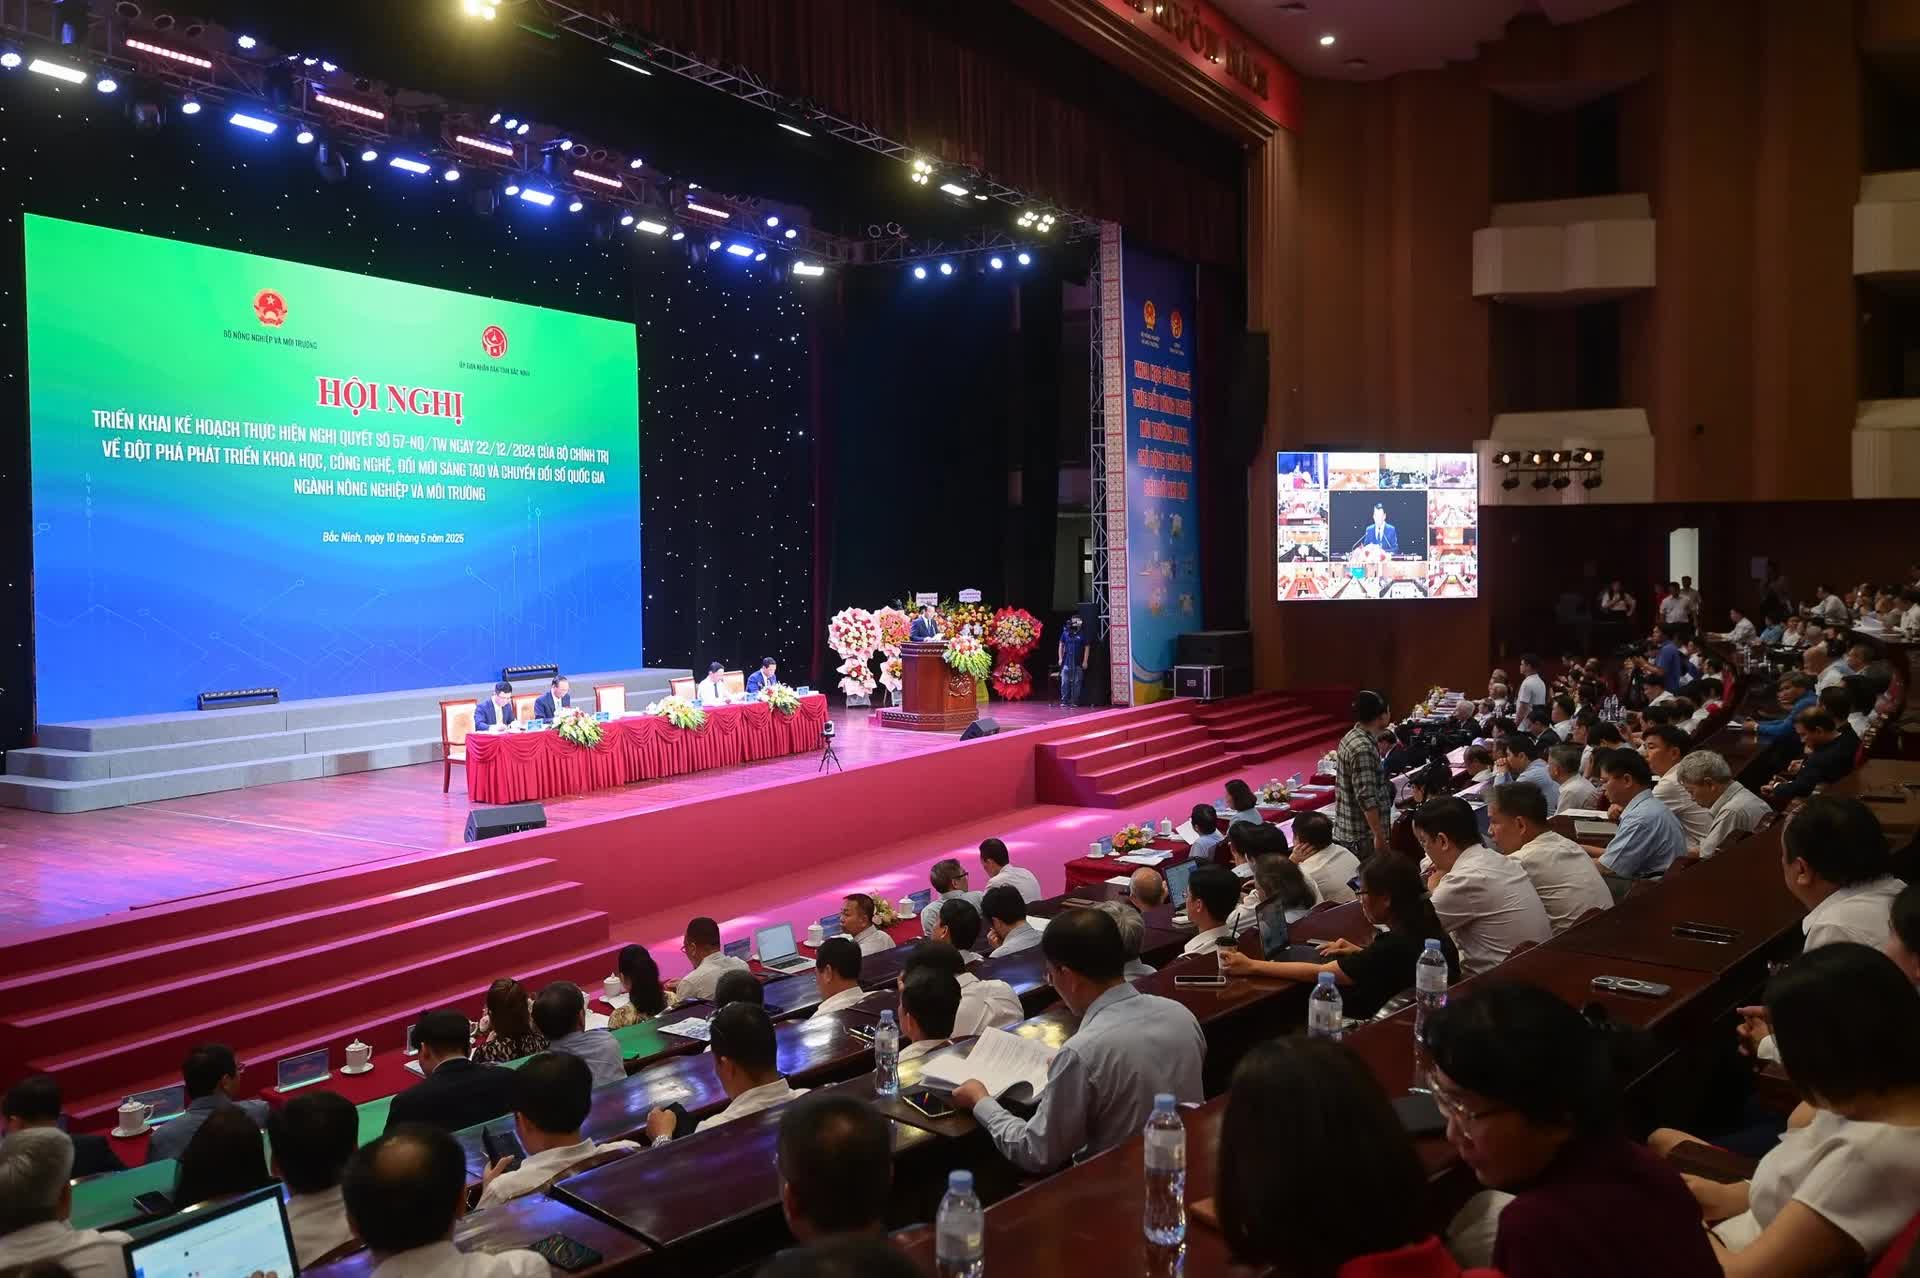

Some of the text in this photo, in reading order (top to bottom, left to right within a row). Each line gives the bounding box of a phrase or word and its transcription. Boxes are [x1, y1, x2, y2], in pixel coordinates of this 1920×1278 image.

[316, 375, 464, 426] HỘI NGHỊ
[92, 407, 134, 430] TRIỂN
[138, 413, 171, 433] KHAI
[175, 413, 193, 434] KẾ
[195, 418, 240, 440] HOẠCH
[243, 421, 276, 442] THỰC
[279, 423, 306, 444] HIỆN
[309, 427, 337, 446] NGHỊ
[340, 428, 373, 448] QUYẾT
[376, 430, 391, 449] SỐ
[393, 434, 448, 453] 57-NQ/TW
[449, 436, 474, 454] NGÀY
[537, 442, 554, 460] CỦA
[556, 443, 569, 462] BỘ
[570, 445, 595, 463] CHÍNH
[596, 448, 609, 466] TRỊ
[102, 436, 606, 485] VỀ ĐỘT PHÁ PHÁT TRIỂN KHOA HỌC, CÔNG NGHỆ, ĐỔI MỚI SÁNG TẠO VÀ CHUYỂN ĐỔI SỐ QUỐC GIA
[294, 476, 486, 502] NGÀNH NÔNG NGHIỆP VÀ MÔI TRƯỜNG
[322, 531, 340, 544] Bắc
[341, 531, 363, 545] Ninh,
[364, 532, 385, 546] ngày
[386, 532, 395, 544] 10
[396, 532, 420, 546] tháng
[445, 533, 465, 545] 2025
